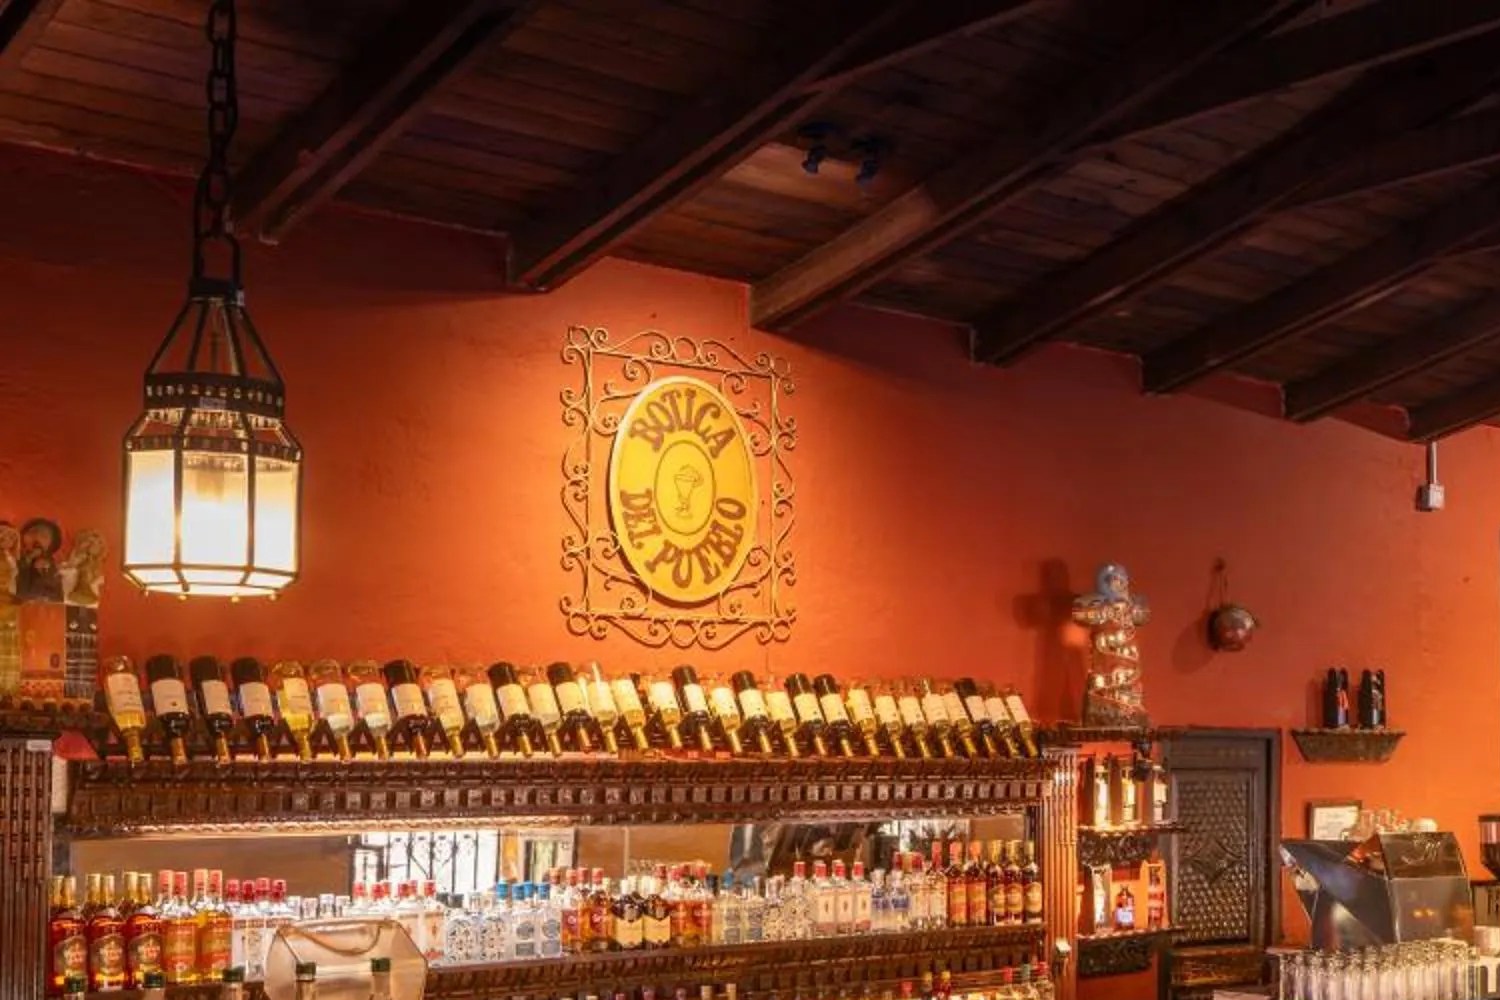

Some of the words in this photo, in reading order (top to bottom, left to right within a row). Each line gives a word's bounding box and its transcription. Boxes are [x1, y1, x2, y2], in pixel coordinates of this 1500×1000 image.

[630, 388, 736, 458] BOTICA
[620, 487, 663, 550] DEL
[645, 498, 746, 588] PUEBLO
